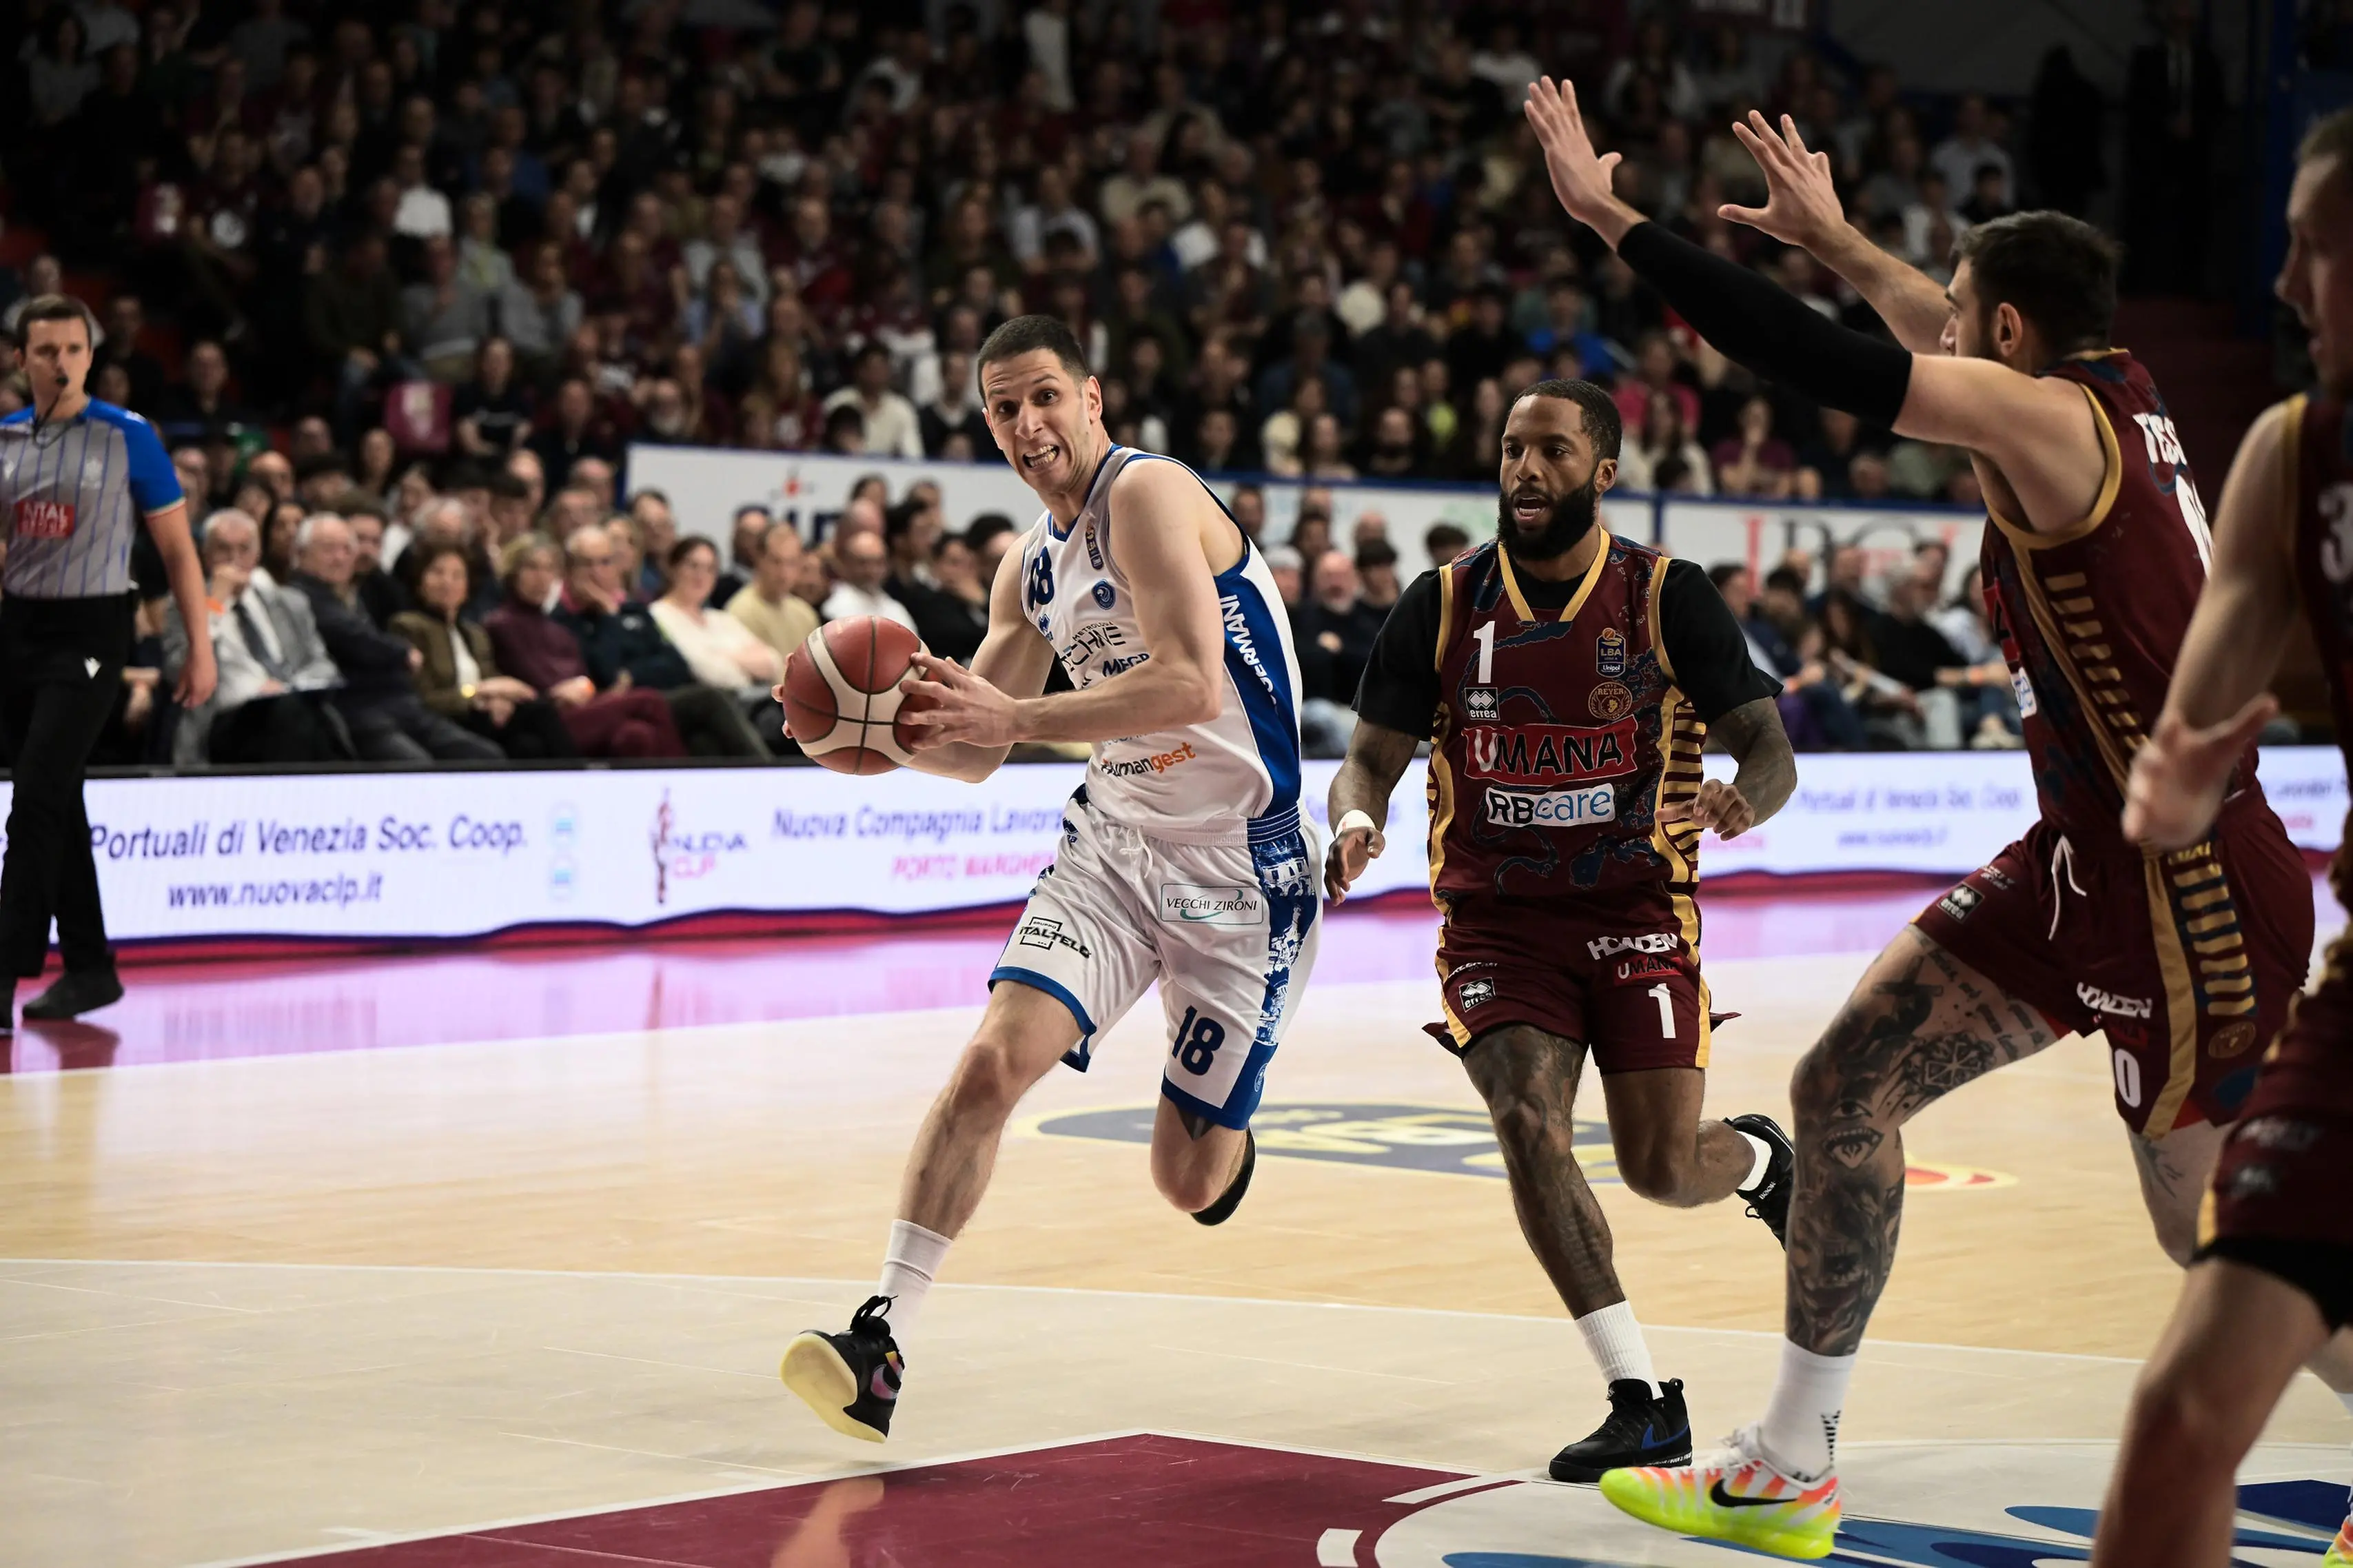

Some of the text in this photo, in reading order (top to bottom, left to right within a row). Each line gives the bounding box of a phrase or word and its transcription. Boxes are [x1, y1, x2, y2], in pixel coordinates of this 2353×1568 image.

[1028, 546, 1055, 613] 18
[1474, 620, 1496, 684] 1
[1600, 648, 1622, 656] LBA
[1469, 709, 1498, 718] errea
[1474, 729, 1623, 776] UMANA
[1489, 791, 1611, 824] RBcare
[91, 813, 527, 859] Portuali di Venezia Soc. Coop.
[1166, 898, 1257, 910] VECCHI ZIRONI
[1649, 983, 1676, 1039] 1
[1172, 1005, 1225, 1077] 18
